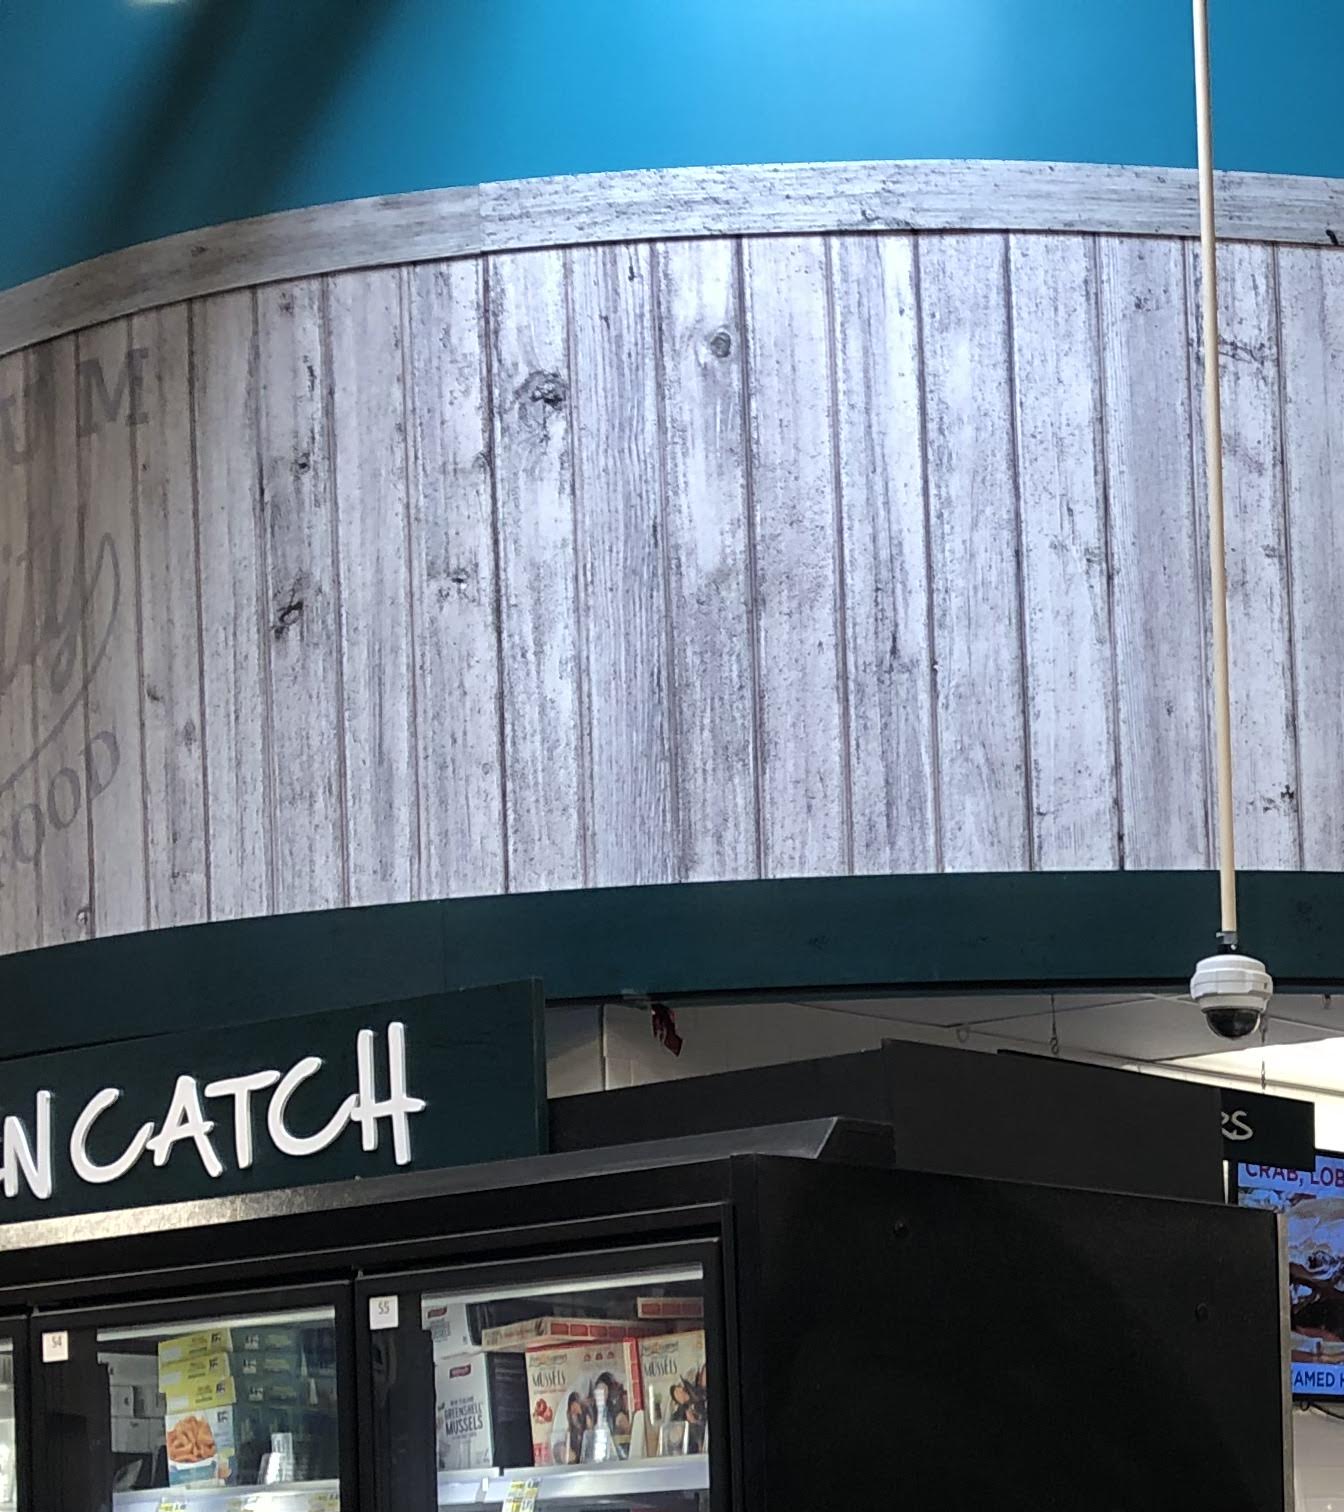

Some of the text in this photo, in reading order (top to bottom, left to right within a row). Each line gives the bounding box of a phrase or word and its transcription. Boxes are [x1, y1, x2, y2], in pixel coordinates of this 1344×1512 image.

[70, 1022, 426, 1185] CATCH
[1291, 1371, 1335, 1387] AMED
[446, 1415, 483, 1436] MUSSELS
